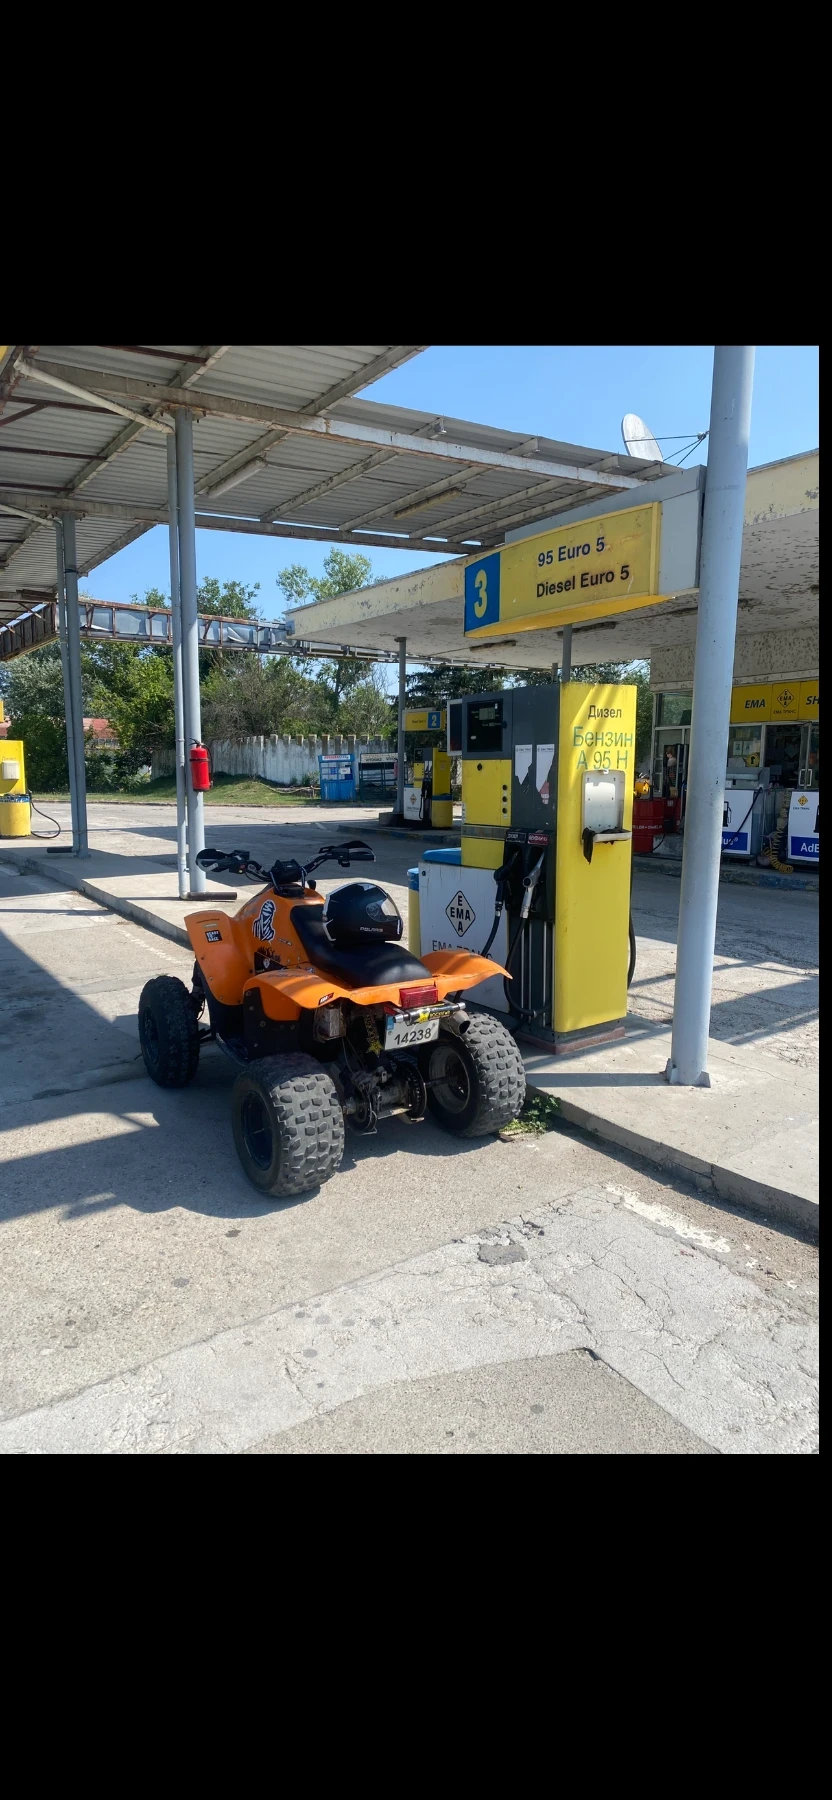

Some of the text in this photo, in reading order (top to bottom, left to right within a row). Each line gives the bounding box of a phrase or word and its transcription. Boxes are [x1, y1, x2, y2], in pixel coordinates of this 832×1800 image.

[537, 536, 605, 567] 95 Euro 5
[536, 565, 630, 598] Diesel Euro 5
[473, 569, 488, 619] 3
[588, 705, 622, 720] Дизел
[744, 698, 766, 709] EMA
[431, 714, 437, 727] 2
[572, 726, 633, 748] Бензин
[593, 751, 611, 770] 95
[450, 906, 471, 921] EMA
[394, 1028, 432, 1045] 14238
